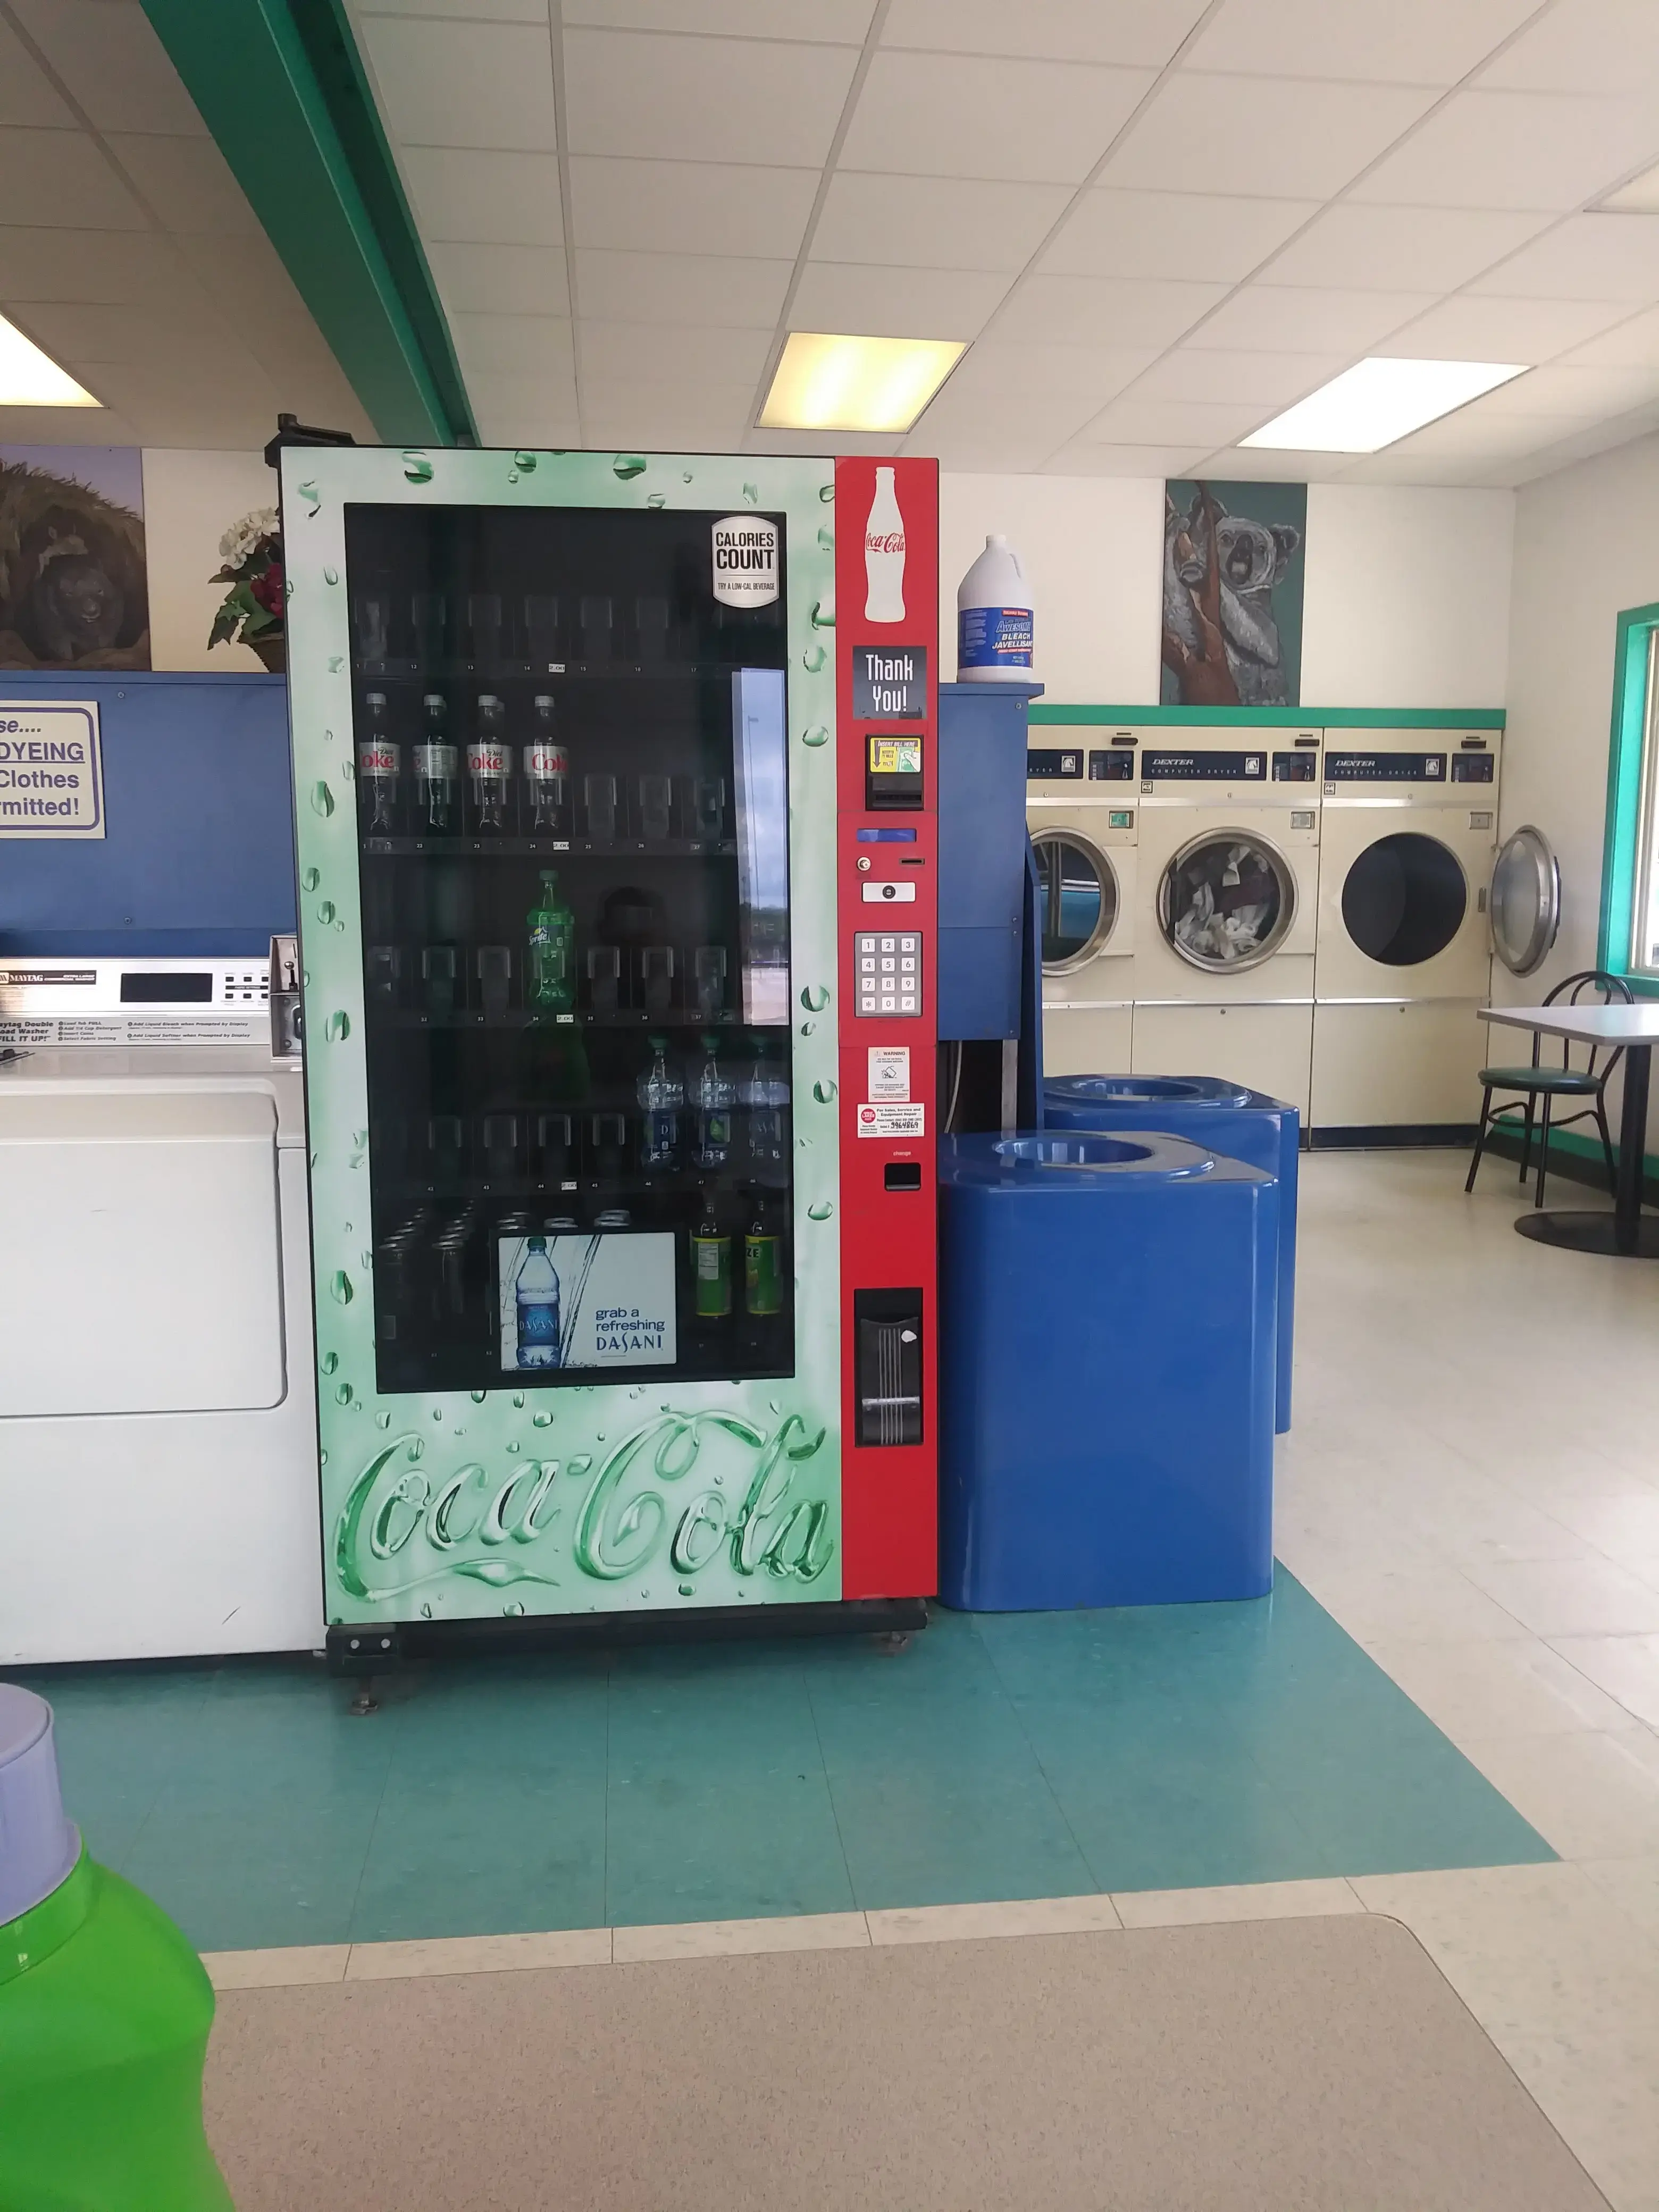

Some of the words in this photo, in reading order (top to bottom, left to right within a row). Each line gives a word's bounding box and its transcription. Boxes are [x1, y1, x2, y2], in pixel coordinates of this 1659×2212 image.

[716, 532, 774, 547] CALORIES
[866, 532, 905, 553] Coca-Cola
[716, 549, 774, 569] COUNT
[865, 654, 914, 681] Thank
[873, 685, 907, 712] You!
[362, 751, 395, 768] oke
[0, 770, 80, 789] Clothes
[0, 798, 79, 816] mitted!
[529, 932, 548, 946] Sprite
[596, 1307, 627, 1321] grab
[631, 1309, 639, 1318] a
[520, 1317, 557, 1331] DASANI
[596, 1319, 665, 1332] refreshing
[597, 1332, 662, 1353] DASANI
[334, 1409, 835, 1602] Coca-Cola
